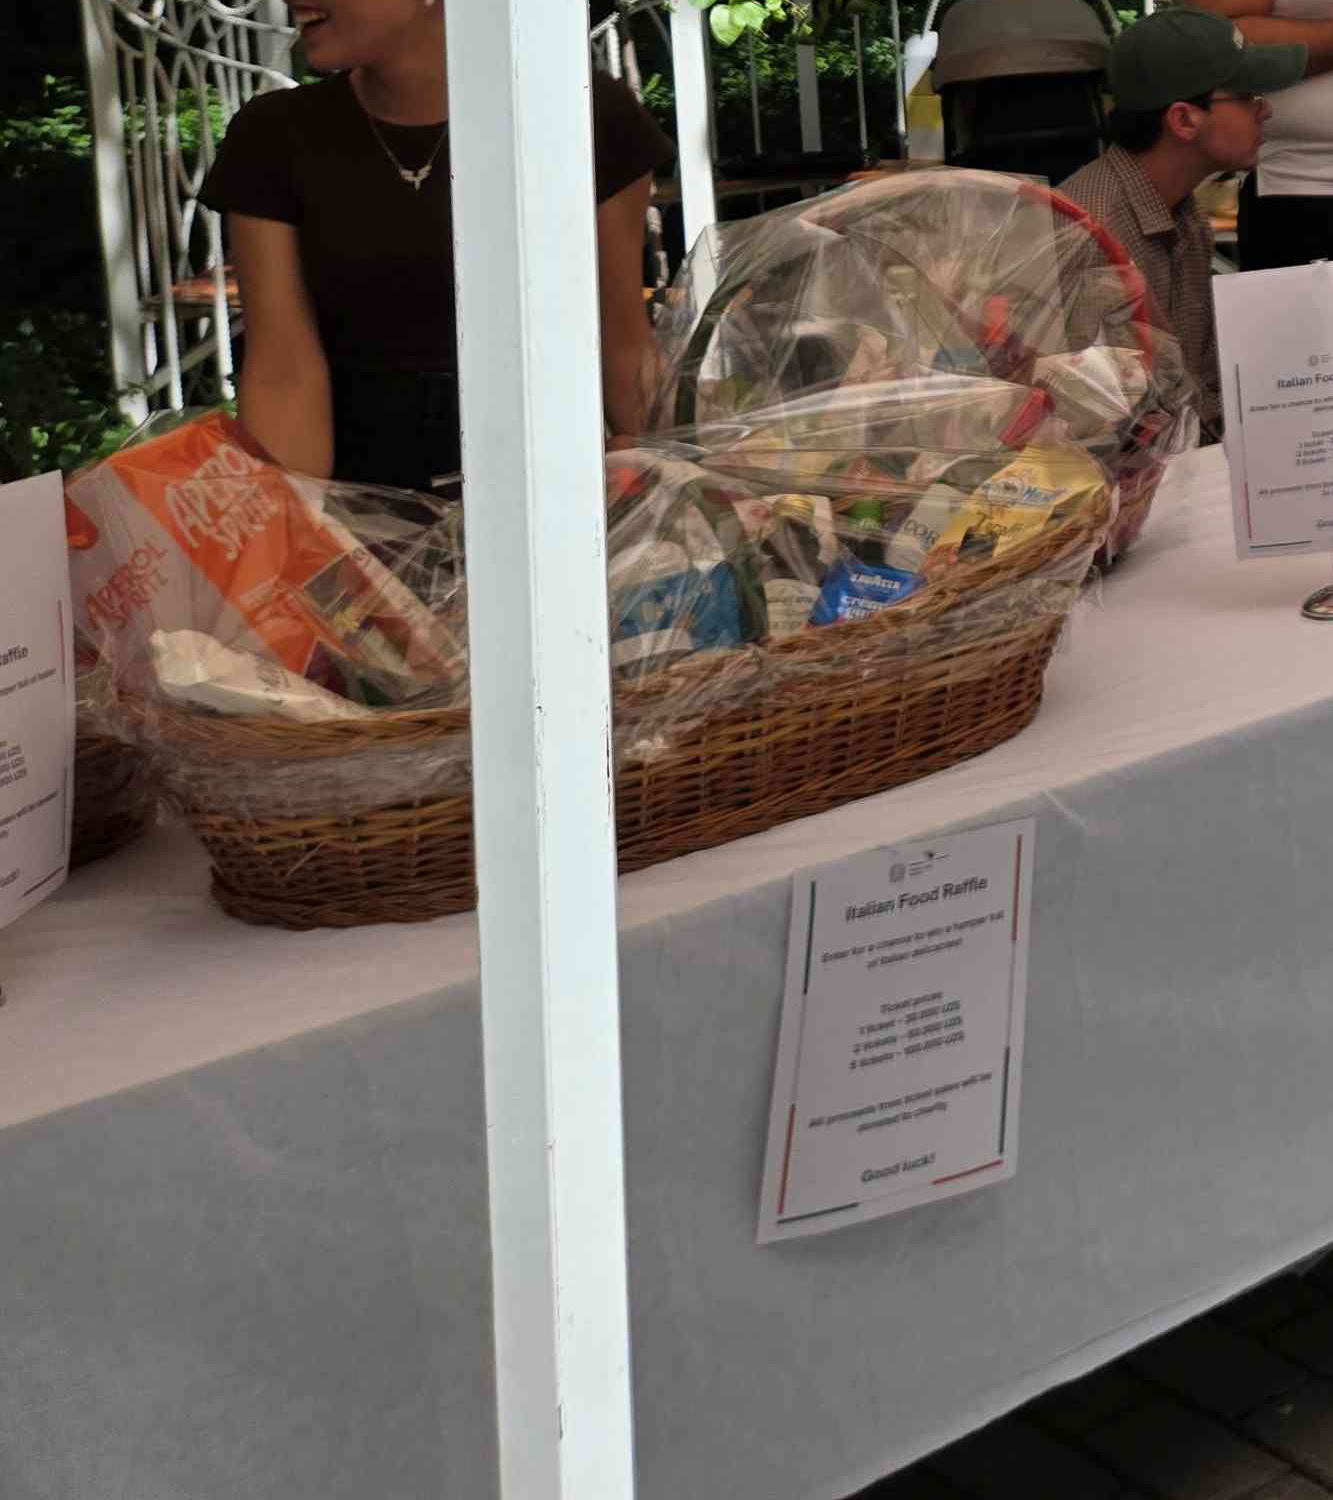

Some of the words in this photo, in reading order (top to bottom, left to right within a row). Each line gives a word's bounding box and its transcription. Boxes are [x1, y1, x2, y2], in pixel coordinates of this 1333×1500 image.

[1277, 376, 1313, 389] Italian
[0, 644, 28, 666] affle
[845, 899, 896, 922] Italian
[898, 886, 939, 909] Food
[942, 876, 988, 899] Raffle
[861, 1164, 901, 1183] Good
